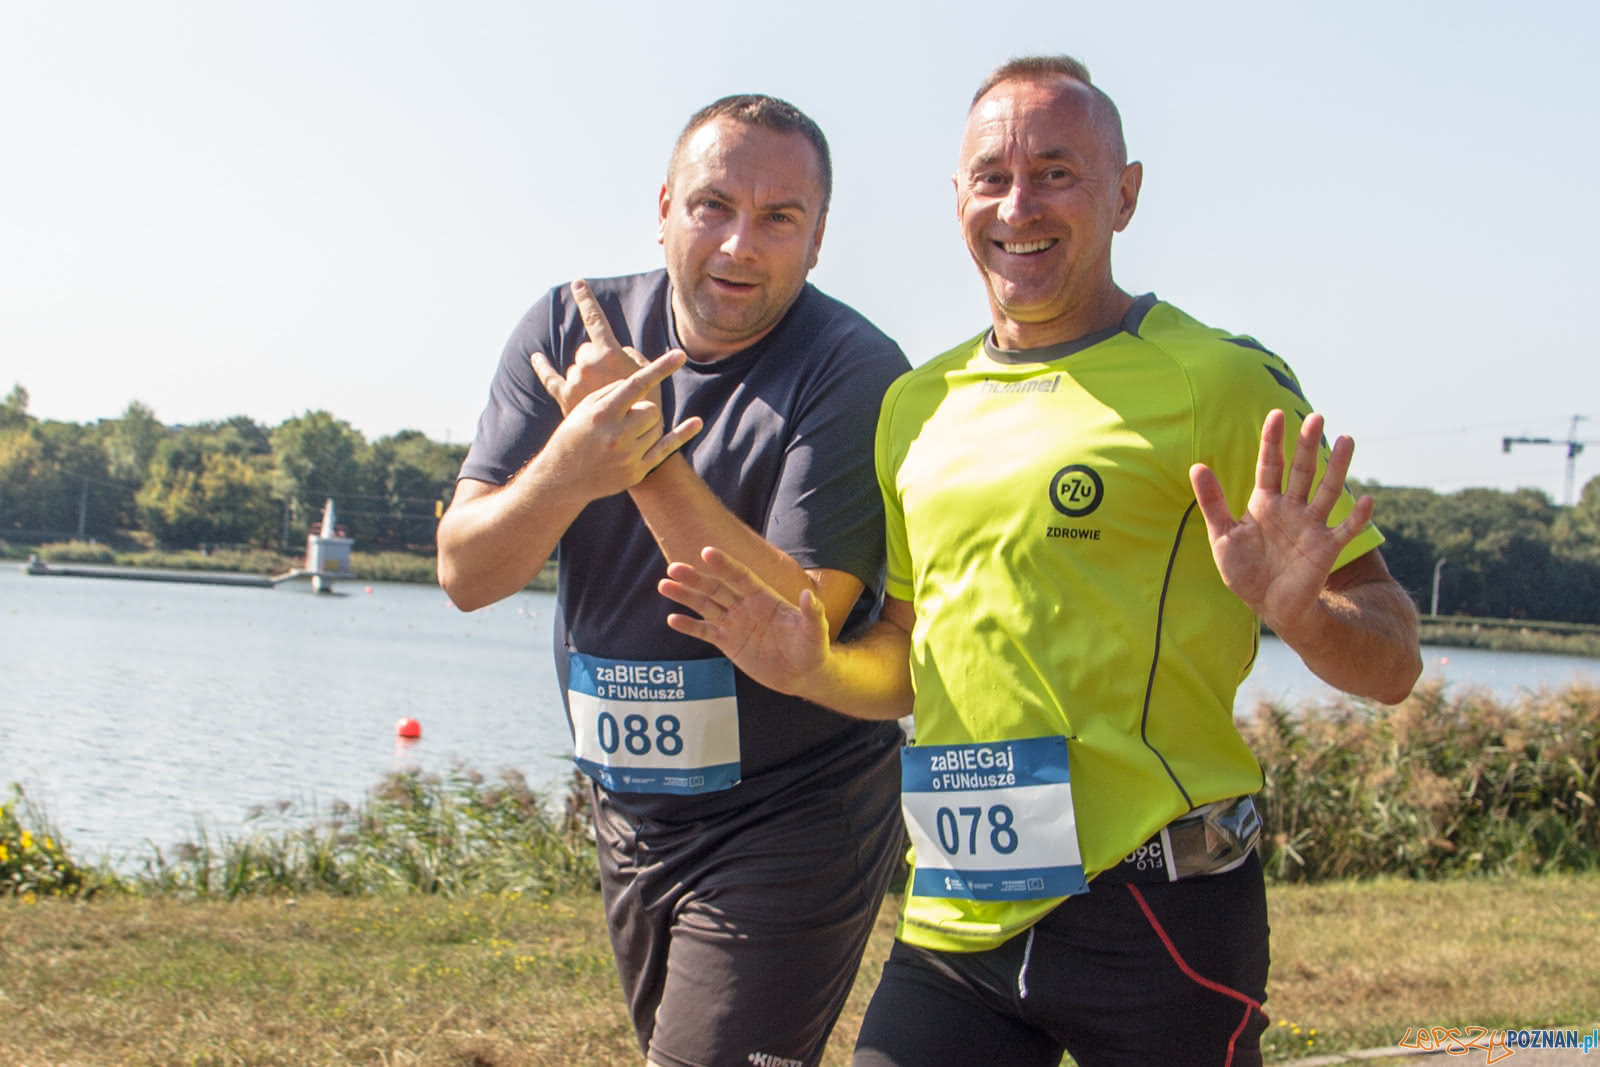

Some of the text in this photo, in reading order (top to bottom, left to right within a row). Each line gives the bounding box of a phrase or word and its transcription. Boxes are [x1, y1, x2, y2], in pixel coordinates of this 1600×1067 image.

[1061, 479, 1091, 502] PZU
[1046, 527, 1101, 540] ZDROWIE
[596, 665, 684, 687] zaBIEGaj
[597, 685, 685, 700] o FUNdusze
[597, 712, 684, 756] 088
[930, 746, 1014, 772] zaBIEGaj
[932, 773, 1016, 790] o FUNdusze
[936, 804, 1019, 855] 078
